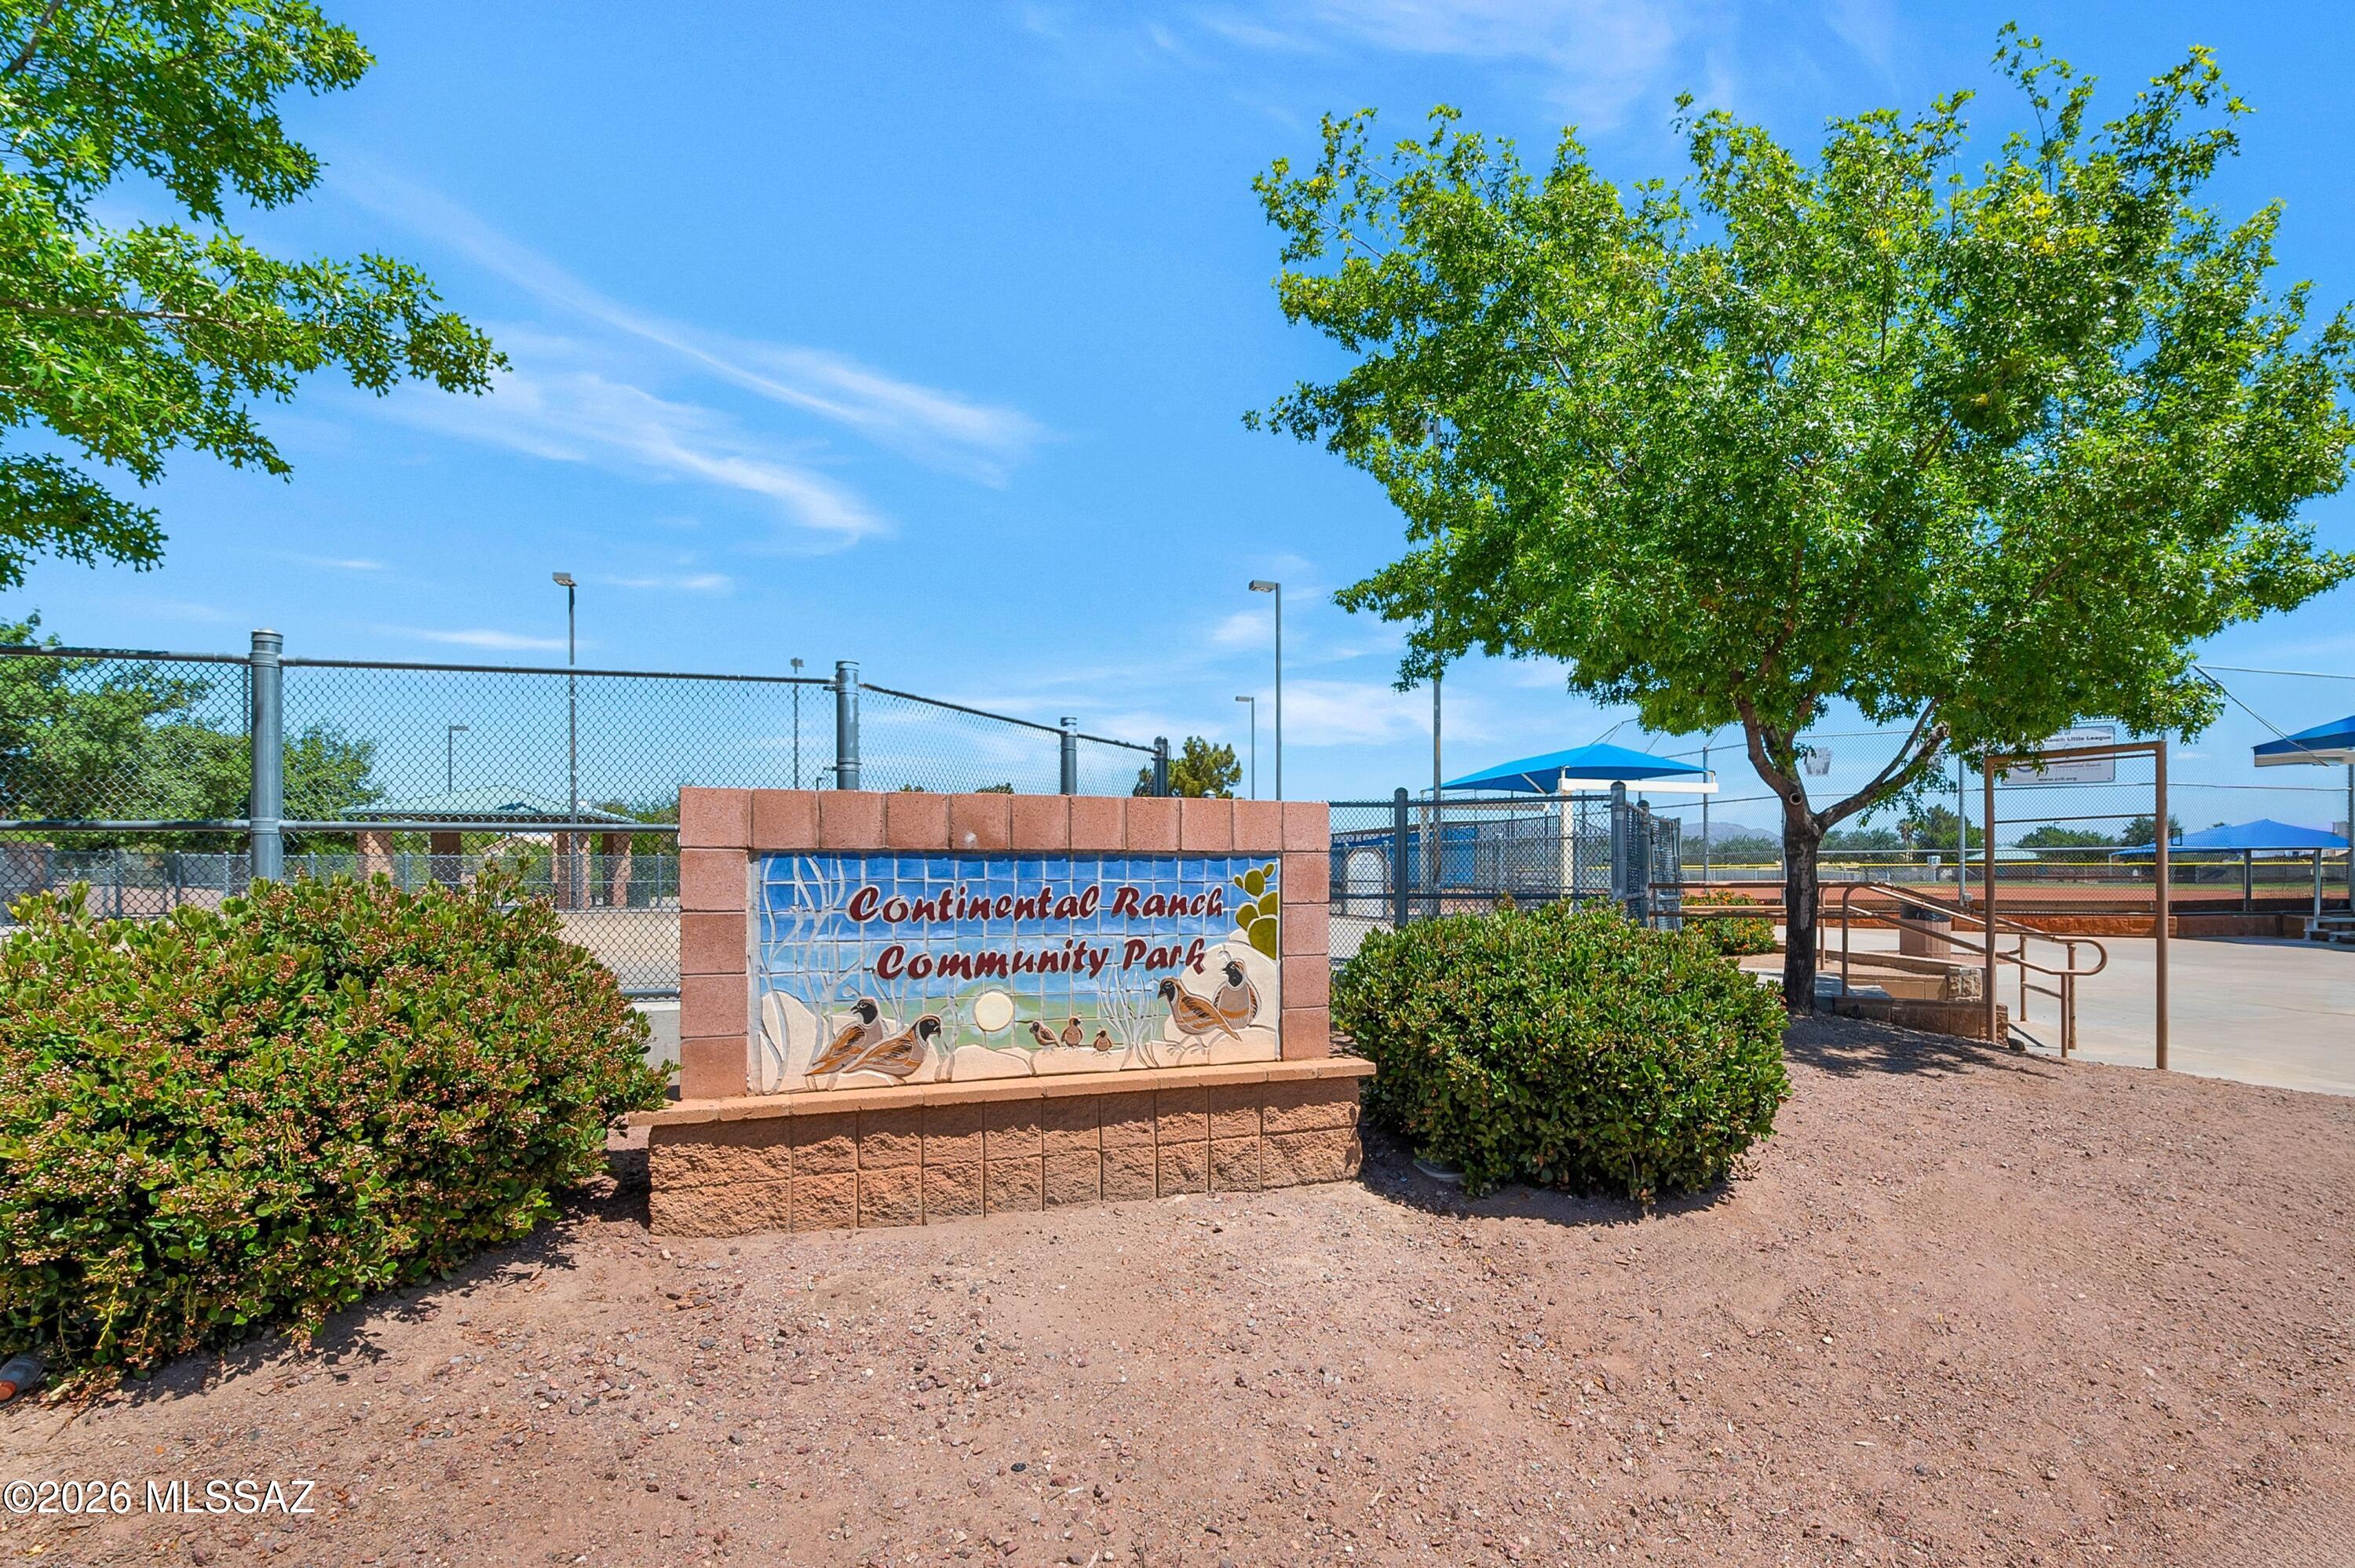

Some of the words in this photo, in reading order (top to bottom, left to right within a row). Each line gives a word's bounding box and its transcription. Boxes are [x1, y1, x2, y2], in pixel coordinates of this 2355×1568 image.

[849, 885, 1100, 922] Continental
[1111, 885, 1222, 919] Ranch
[877, 939, 1109, 980] Community
[1123, 938, 1206, 975] Park
